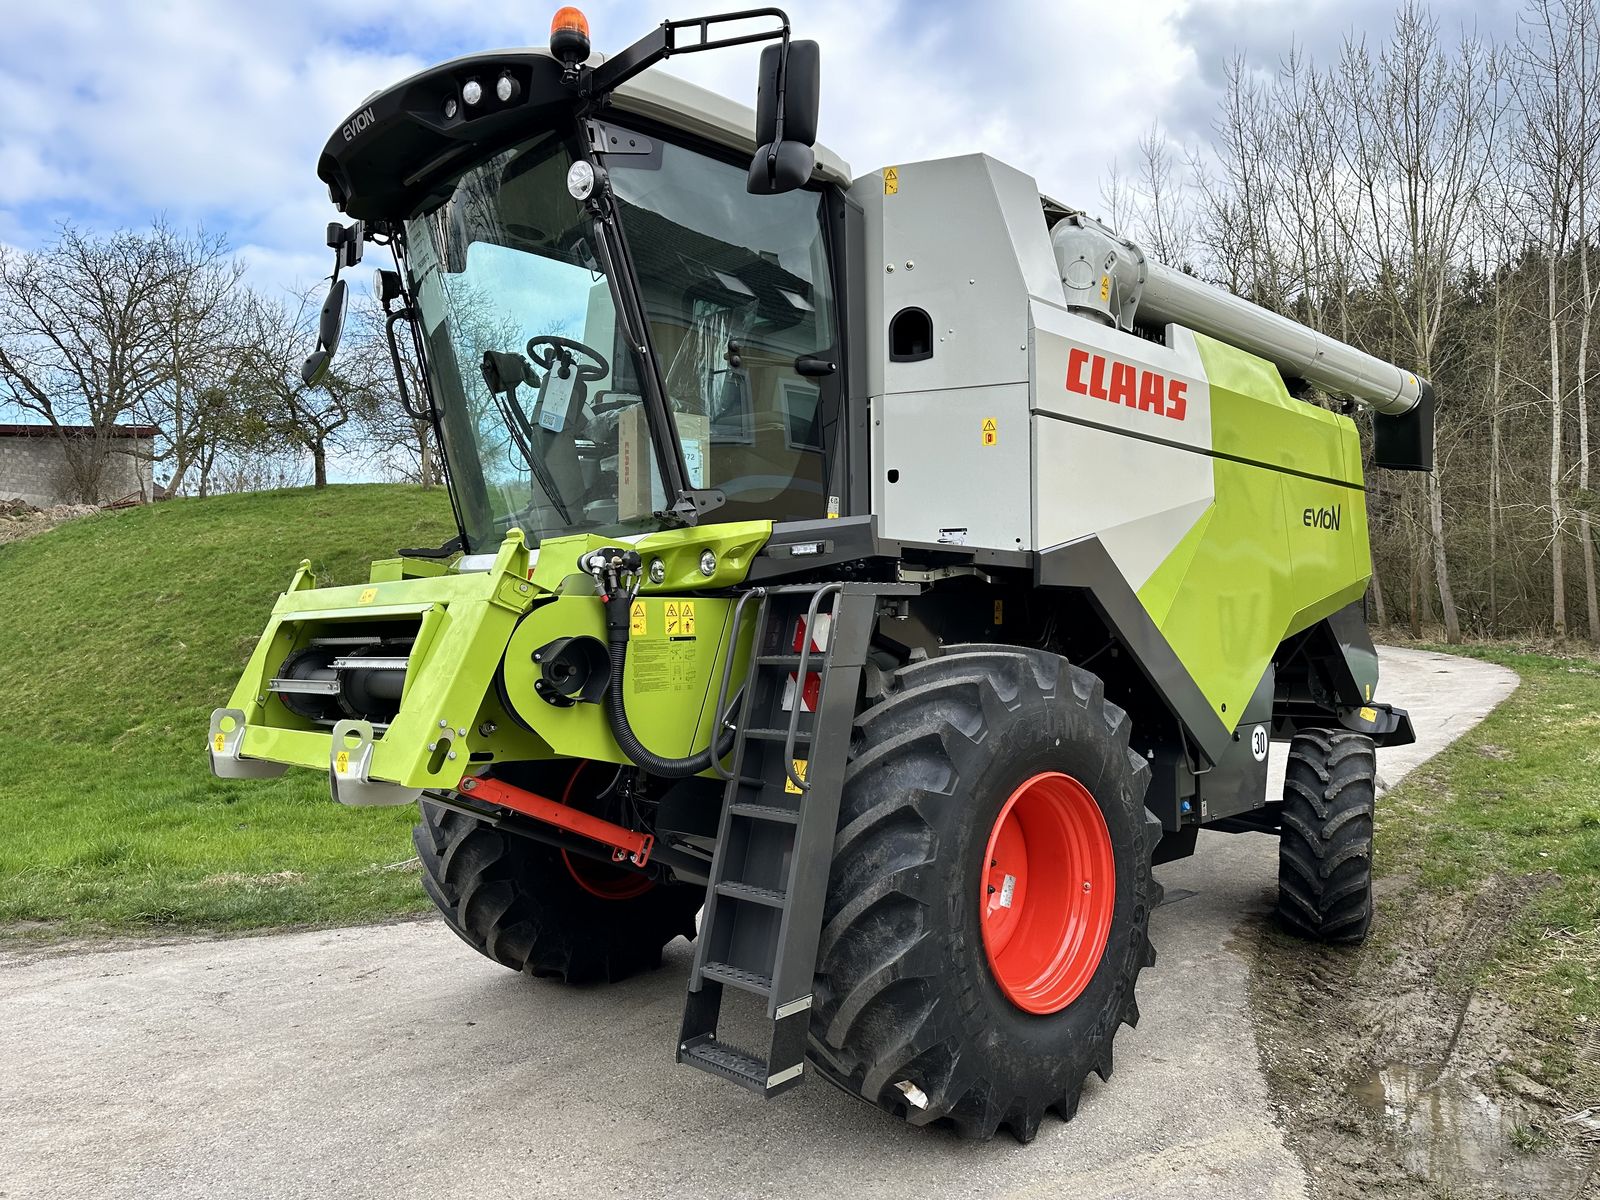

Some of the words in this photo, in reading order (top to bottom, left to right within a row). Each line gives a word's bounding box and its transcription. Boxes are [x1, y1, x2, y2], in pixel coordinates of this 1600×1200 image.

[342, 106, 376, 142] EVION
[1066, 348, 1187, 421] CLAAS
[1303, 503, 1341, 531] EVION
[1254, 731, 1265, 754] 30
